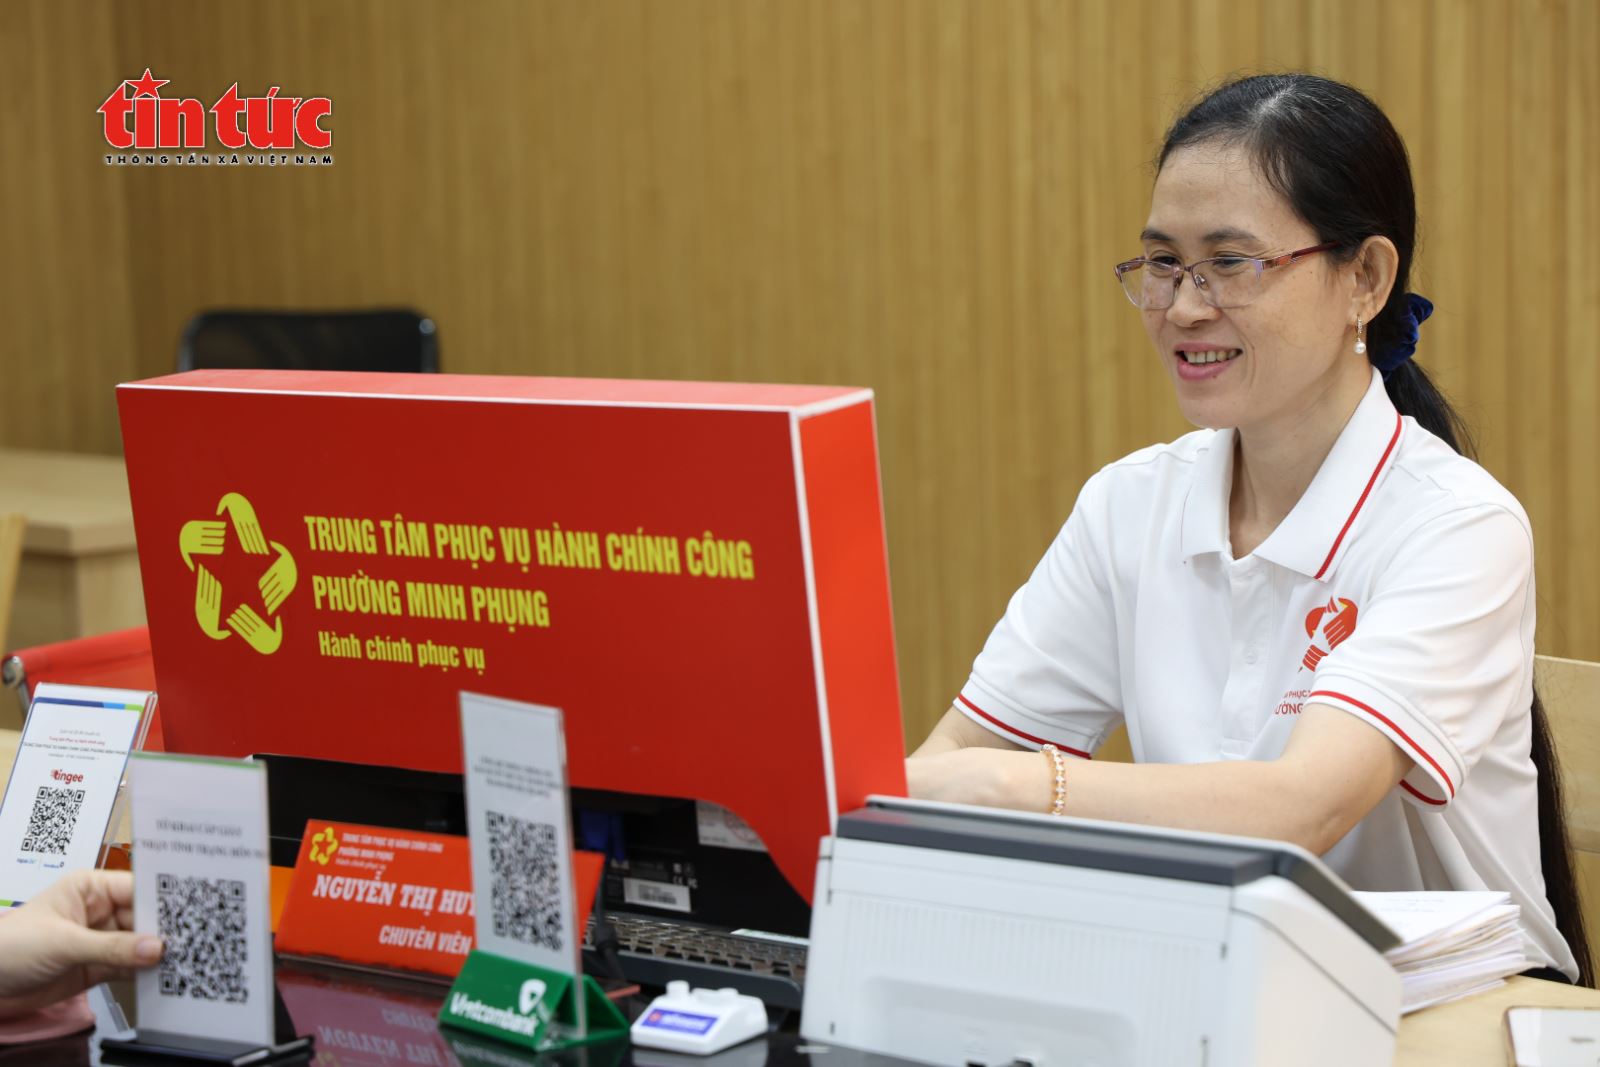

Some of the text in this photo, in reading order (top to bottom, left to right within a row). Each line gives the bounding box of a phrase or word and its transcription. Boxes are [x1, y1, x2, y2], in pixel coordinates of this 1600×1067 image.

[304, 513, 754, 580] TRUNG TÂM PHỤC VỤ HÀNH CHÍNH CÔNG
[312, 569, 550, 633] PHƯỜNG MINH PHỤNG
[318, 630, 486, 676] Hành chính phục vụ
[313, 868, 397, 906] NGUYỄN
[400, 884, 438, 916] THỊ
[378, 924, 472, 956] CHUYÊN VIÊN
